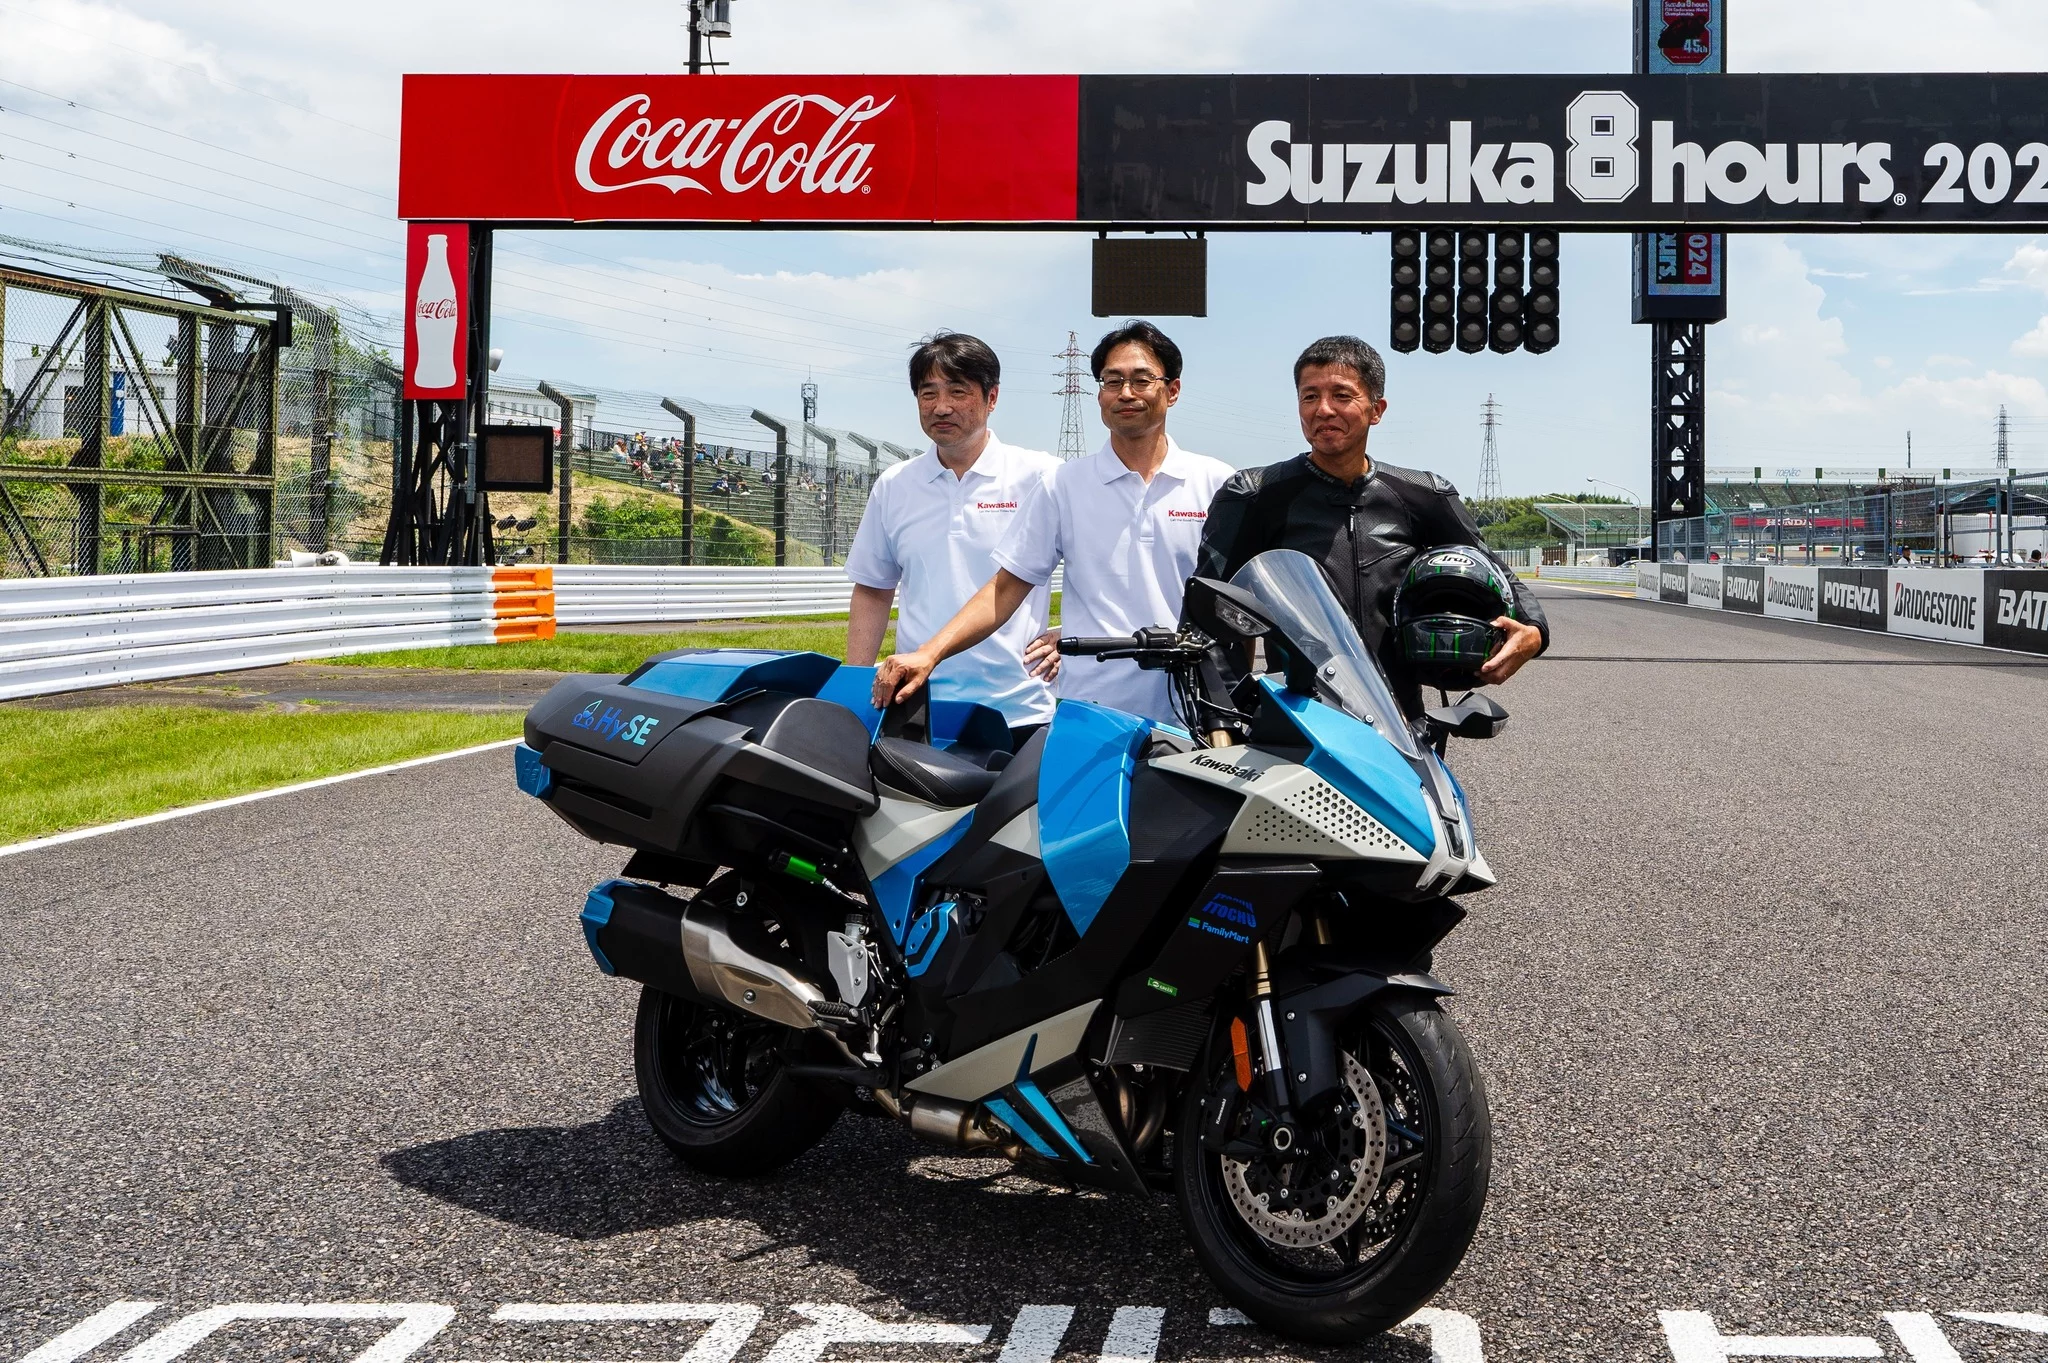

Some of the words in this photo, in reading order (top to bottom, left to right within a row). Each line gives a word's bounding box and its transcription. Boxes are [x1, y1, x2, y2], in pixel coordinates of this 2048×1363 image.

[575, 93, 896, 195] Coca-Cola
[1246, 120, 1554, 206] Suzuka
[1566, 90, 1639, 203] 8
[977, 501, 1018, 509] Kawasaki
[1168, 510, 1208, 518] Kawasak
[1662, 572, 1686, 593] POTENZA
[1690, 573, 1721, 600] BRIDGESTONE
[1726, 576, 1760, 603] BATTLAX
[1767, 576, 1814, 612] BRIDGESTONE
[1824, 581, 1880, 615] POTENZA
[1893, 582, 1977, 631] BRIDGESTONE
[593, 706, 660, 746] HySE
[1189, 754, 1265, 782] Kawasaki
[1202, 900, 1257, 928] ITOCHU
[1202, 922, 1250, 944] FamilyMart
